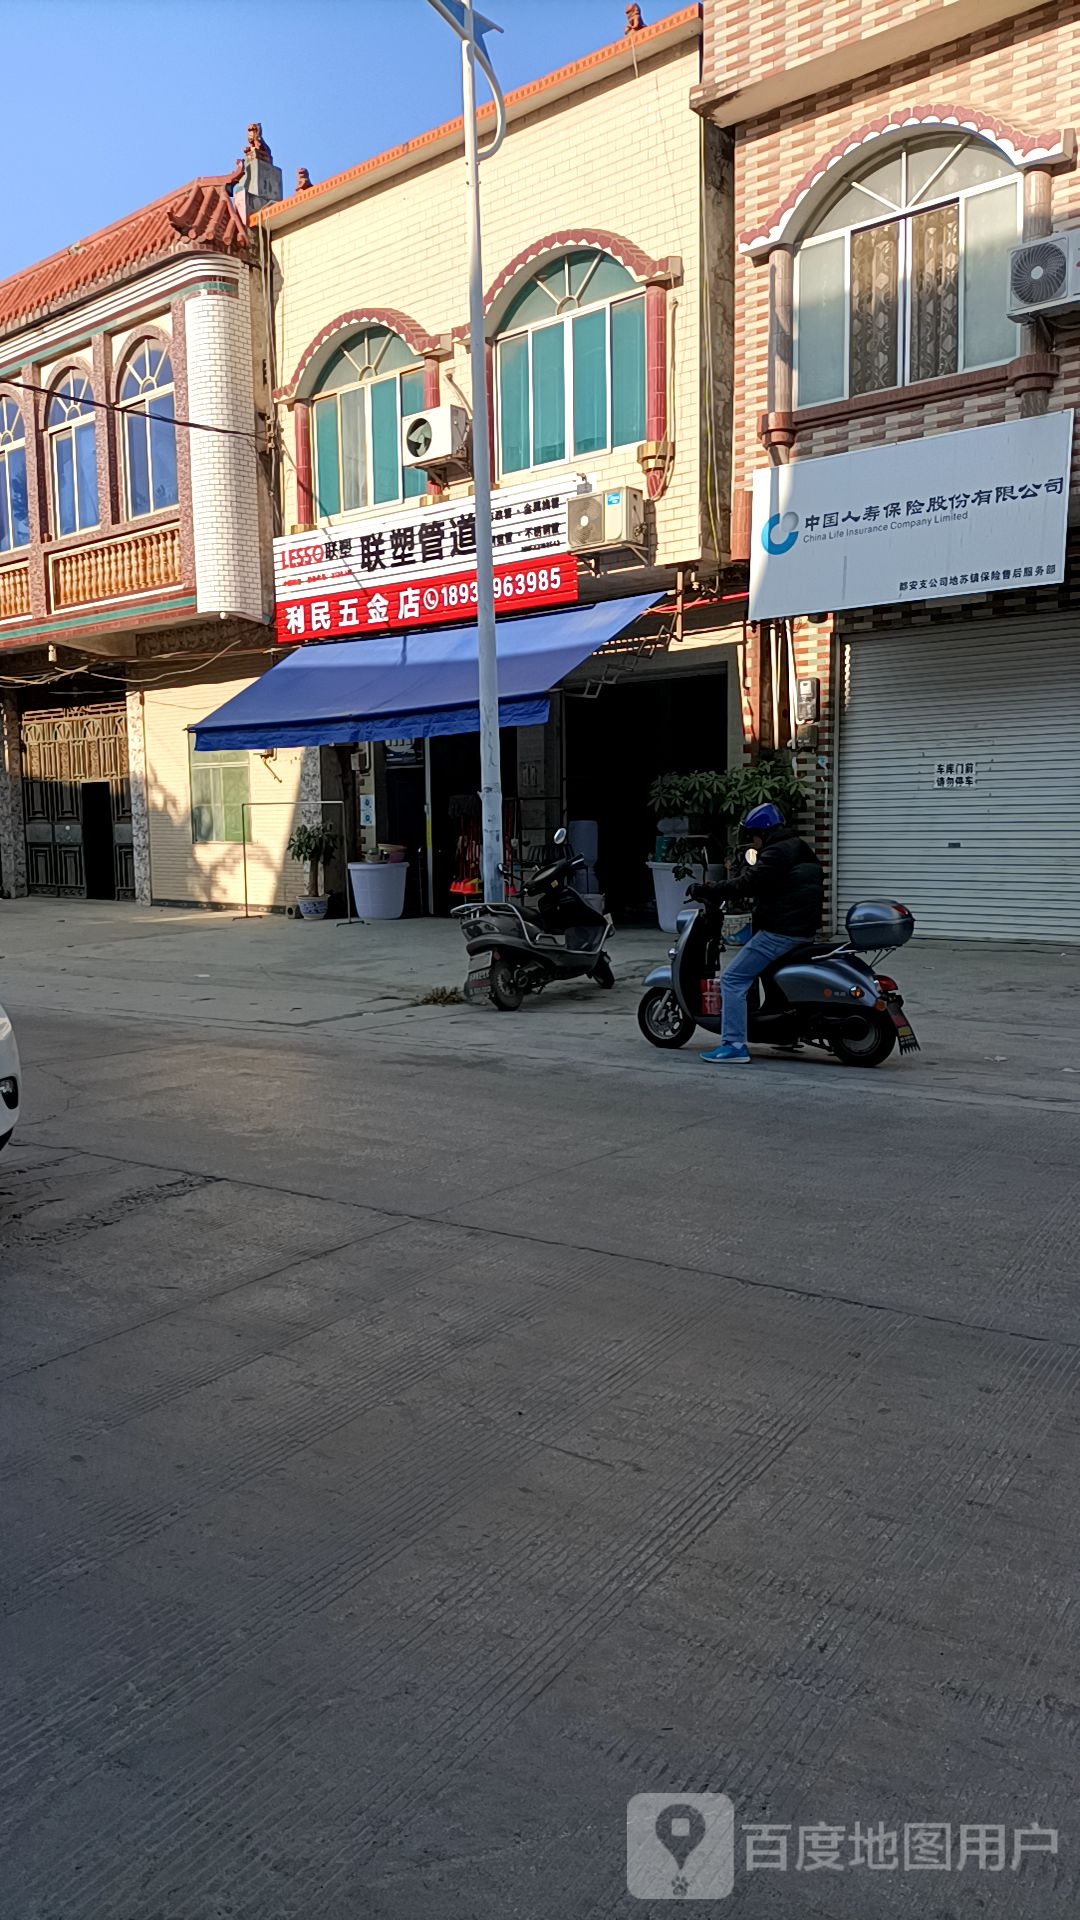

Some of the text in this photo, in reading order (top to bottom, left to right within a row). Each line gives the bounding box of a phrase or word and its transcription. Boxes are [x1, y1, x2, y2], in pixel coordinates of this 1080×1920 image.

[804, 477, 1064, 532] 中国人寿保险股份有限公司
[359, 512, 477, 572] 联塑管道
[803, 510, 969, 544] China Life Insurance Company Limited
[281, 544, 325, 570] LESSO
[325, 538, 352, 561] 联塑
[440, 567, 561, 607] 1893963985
[285, 586, 421, 635] 利民五金店
[936, 762, 974, 775] 车库门前
[936, 775, 974, 788] 请勿停车
